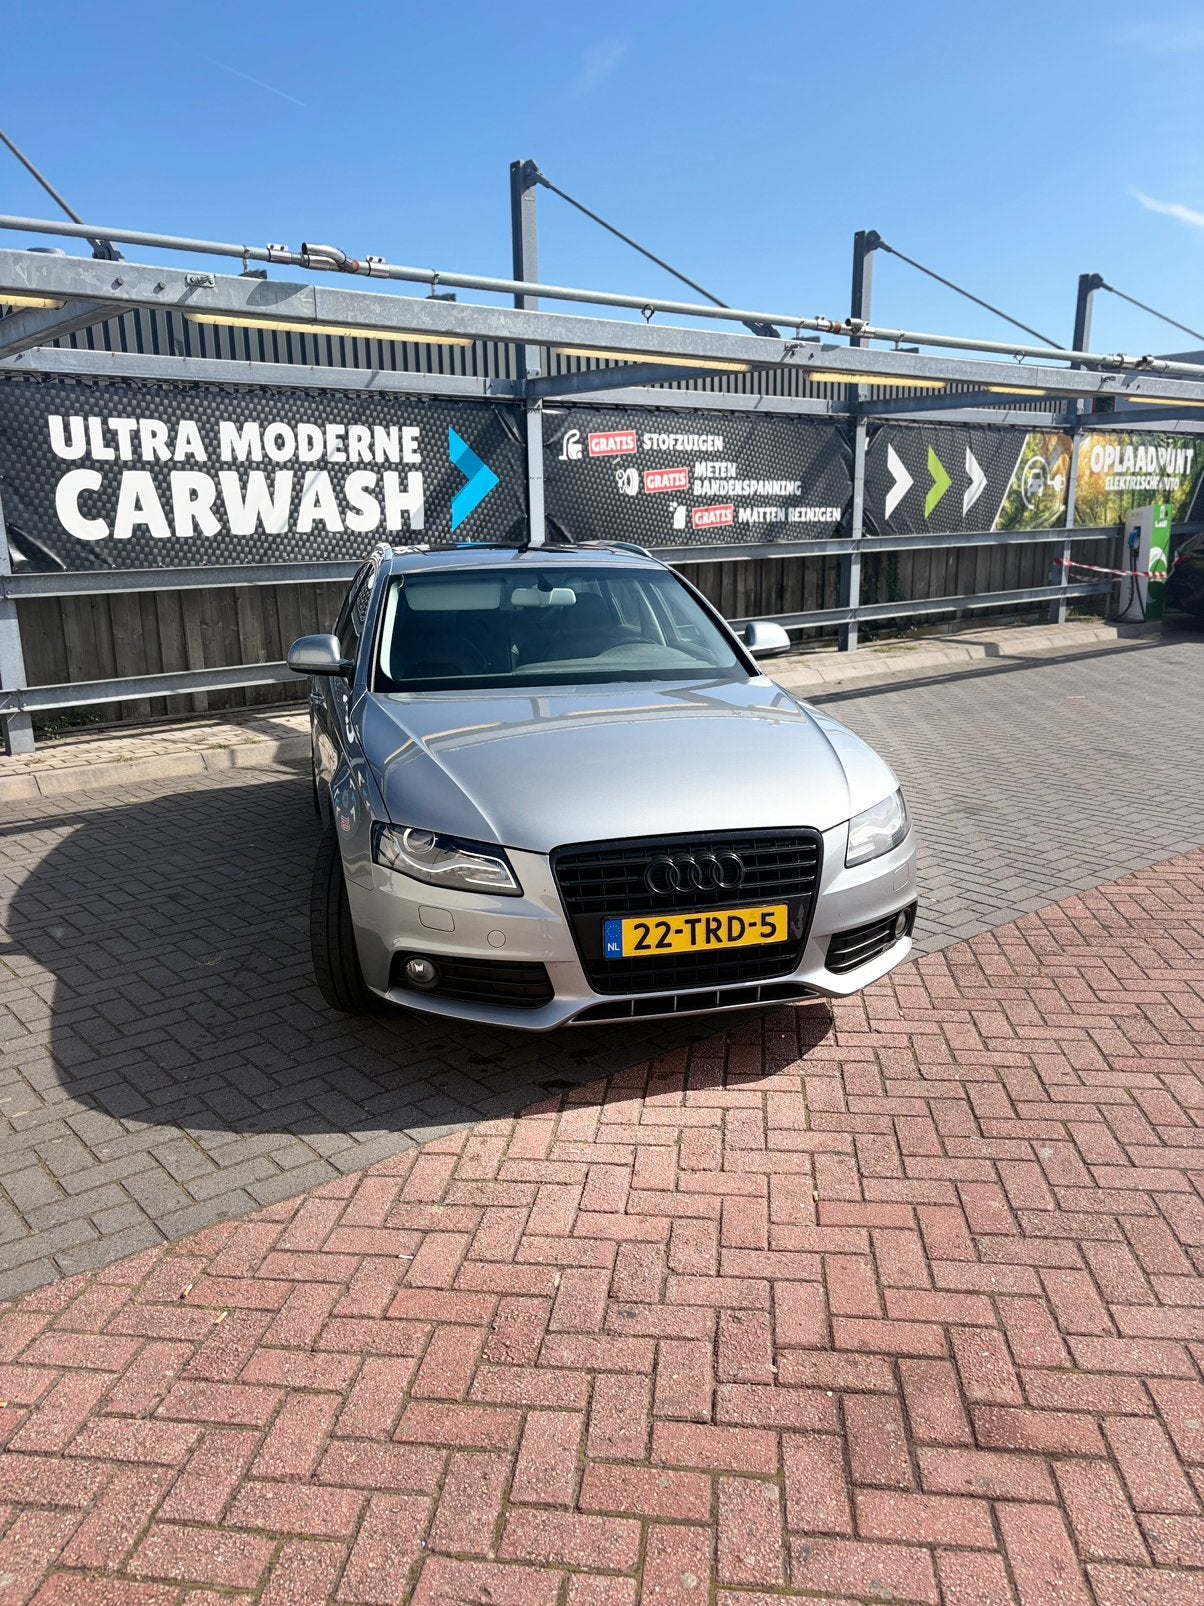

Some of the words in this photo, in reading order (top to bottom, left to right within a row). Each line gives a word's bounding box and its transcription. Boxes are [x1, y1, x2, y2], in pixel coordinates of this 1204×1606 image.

[48, 415, 207, 462] ULTRA
[219, 421, 421, 463] MODERNE
[591, 435, 634, 452] GRATIS
[642, 433, 724, 452] STOFZUIGEN
[694, 461, 737, 478] METEN
[1090, 445, 1194, 475] OPLAADPUNT
[646, 472, 686, 489] GRATIS
[693, 480, 802, 496] BANDENSPANNING
[55, 468, 425, 541] CARWASH
[694, 509, 731, 525] GRATIS
[738, 507, 786, 523] MATTEN
[788, 507, 841, 522] REINIGEN
[633, 912, 777, 951] 22-TRD-5
[607, 942, 621, 952] NL
